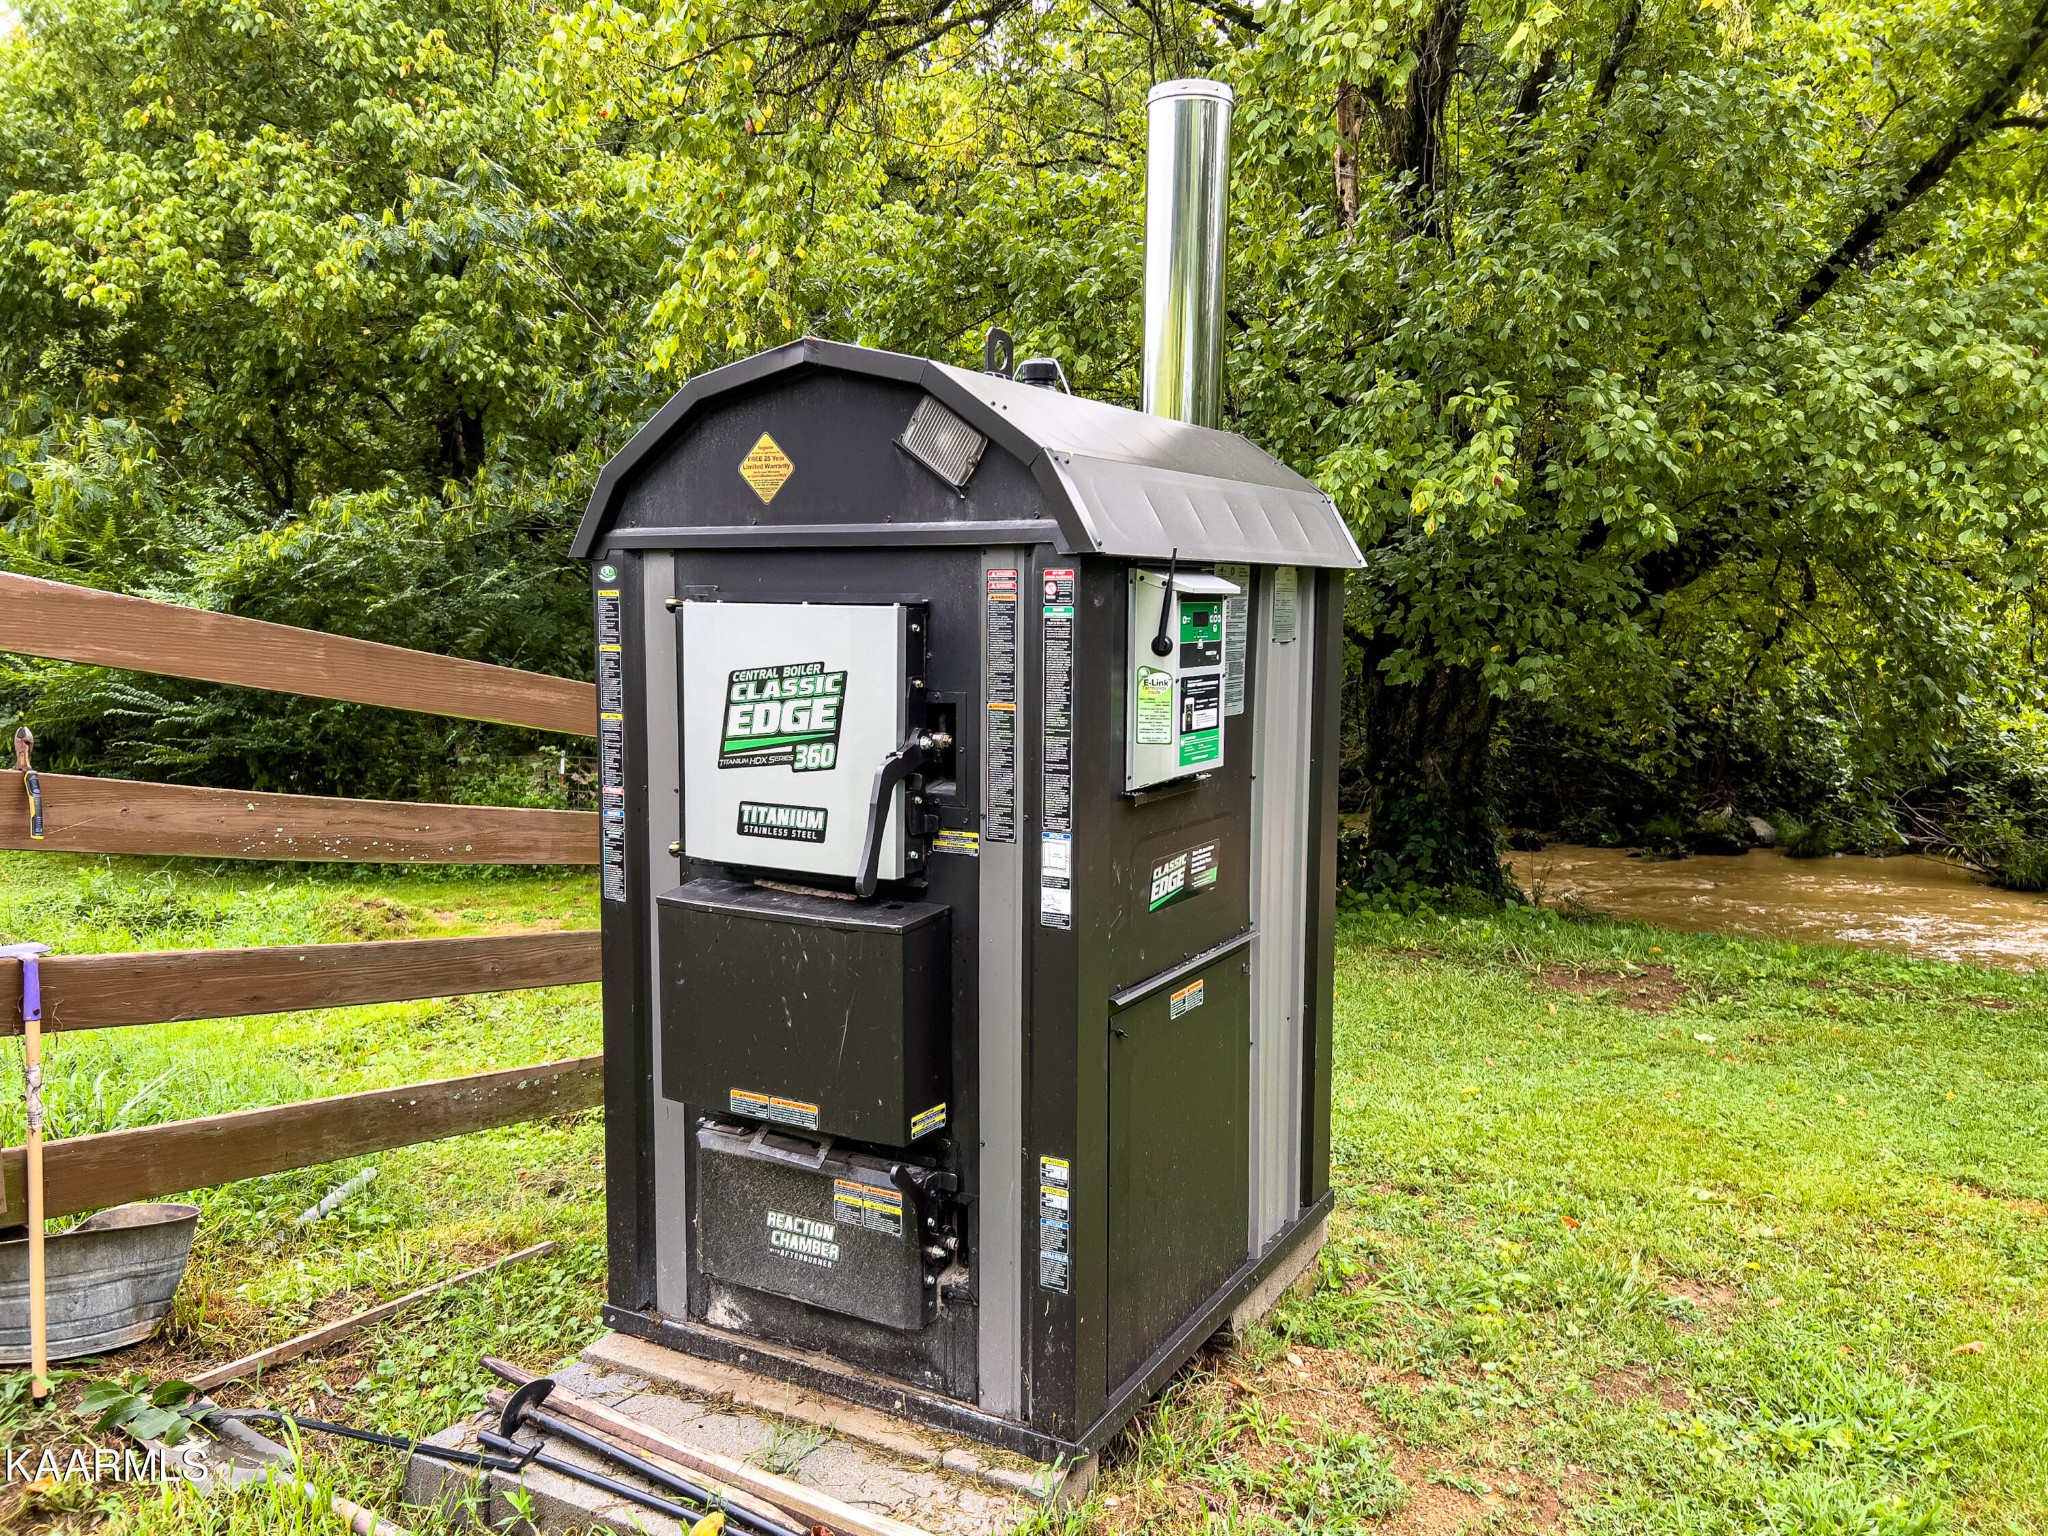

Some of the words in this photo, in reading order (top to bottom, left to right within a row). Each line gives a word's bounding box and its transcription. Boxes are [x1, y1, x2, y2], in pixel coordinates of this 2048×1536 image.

[764, 462, 791, 471] Warranty
[732, 667, 779, 682] CENTRAL
[782, 663, 821, 678] BOILER
[731, 673, 843, 703] CLASSIC
[1143, 679, 1169, 687] E-Link
[726, 695, 840, 738] EDGE
[719, 758, 749, 767] TITANIUM
[749, 757, 768, 765] HDX
[768, 754, 794, 764] SERIES
[793, 742, 836, 770] 360
[741, 804, 826, 831] TITANIUM
[743, 825, 788, 837] STAINLESS
[791, 829, 817, 840] STEEL
[1153, 852, 1188, 881] CLASSIC
[1150, 866, 1187, 903] EDGE
[1044, 1157, 1065, 1166] CAUTION
[841, 1196, 859, 1204] CAUTION
[1043, 1187, 1067, 1196] ATTENTION
[874, 1204, 896, 1213] ATTENTION
[766, 1211, 836, 1241] REACTION
[770, 1230, 840, 1261] CHAMBER
[780, 1249, 832, 1268] AFTERBURNER
